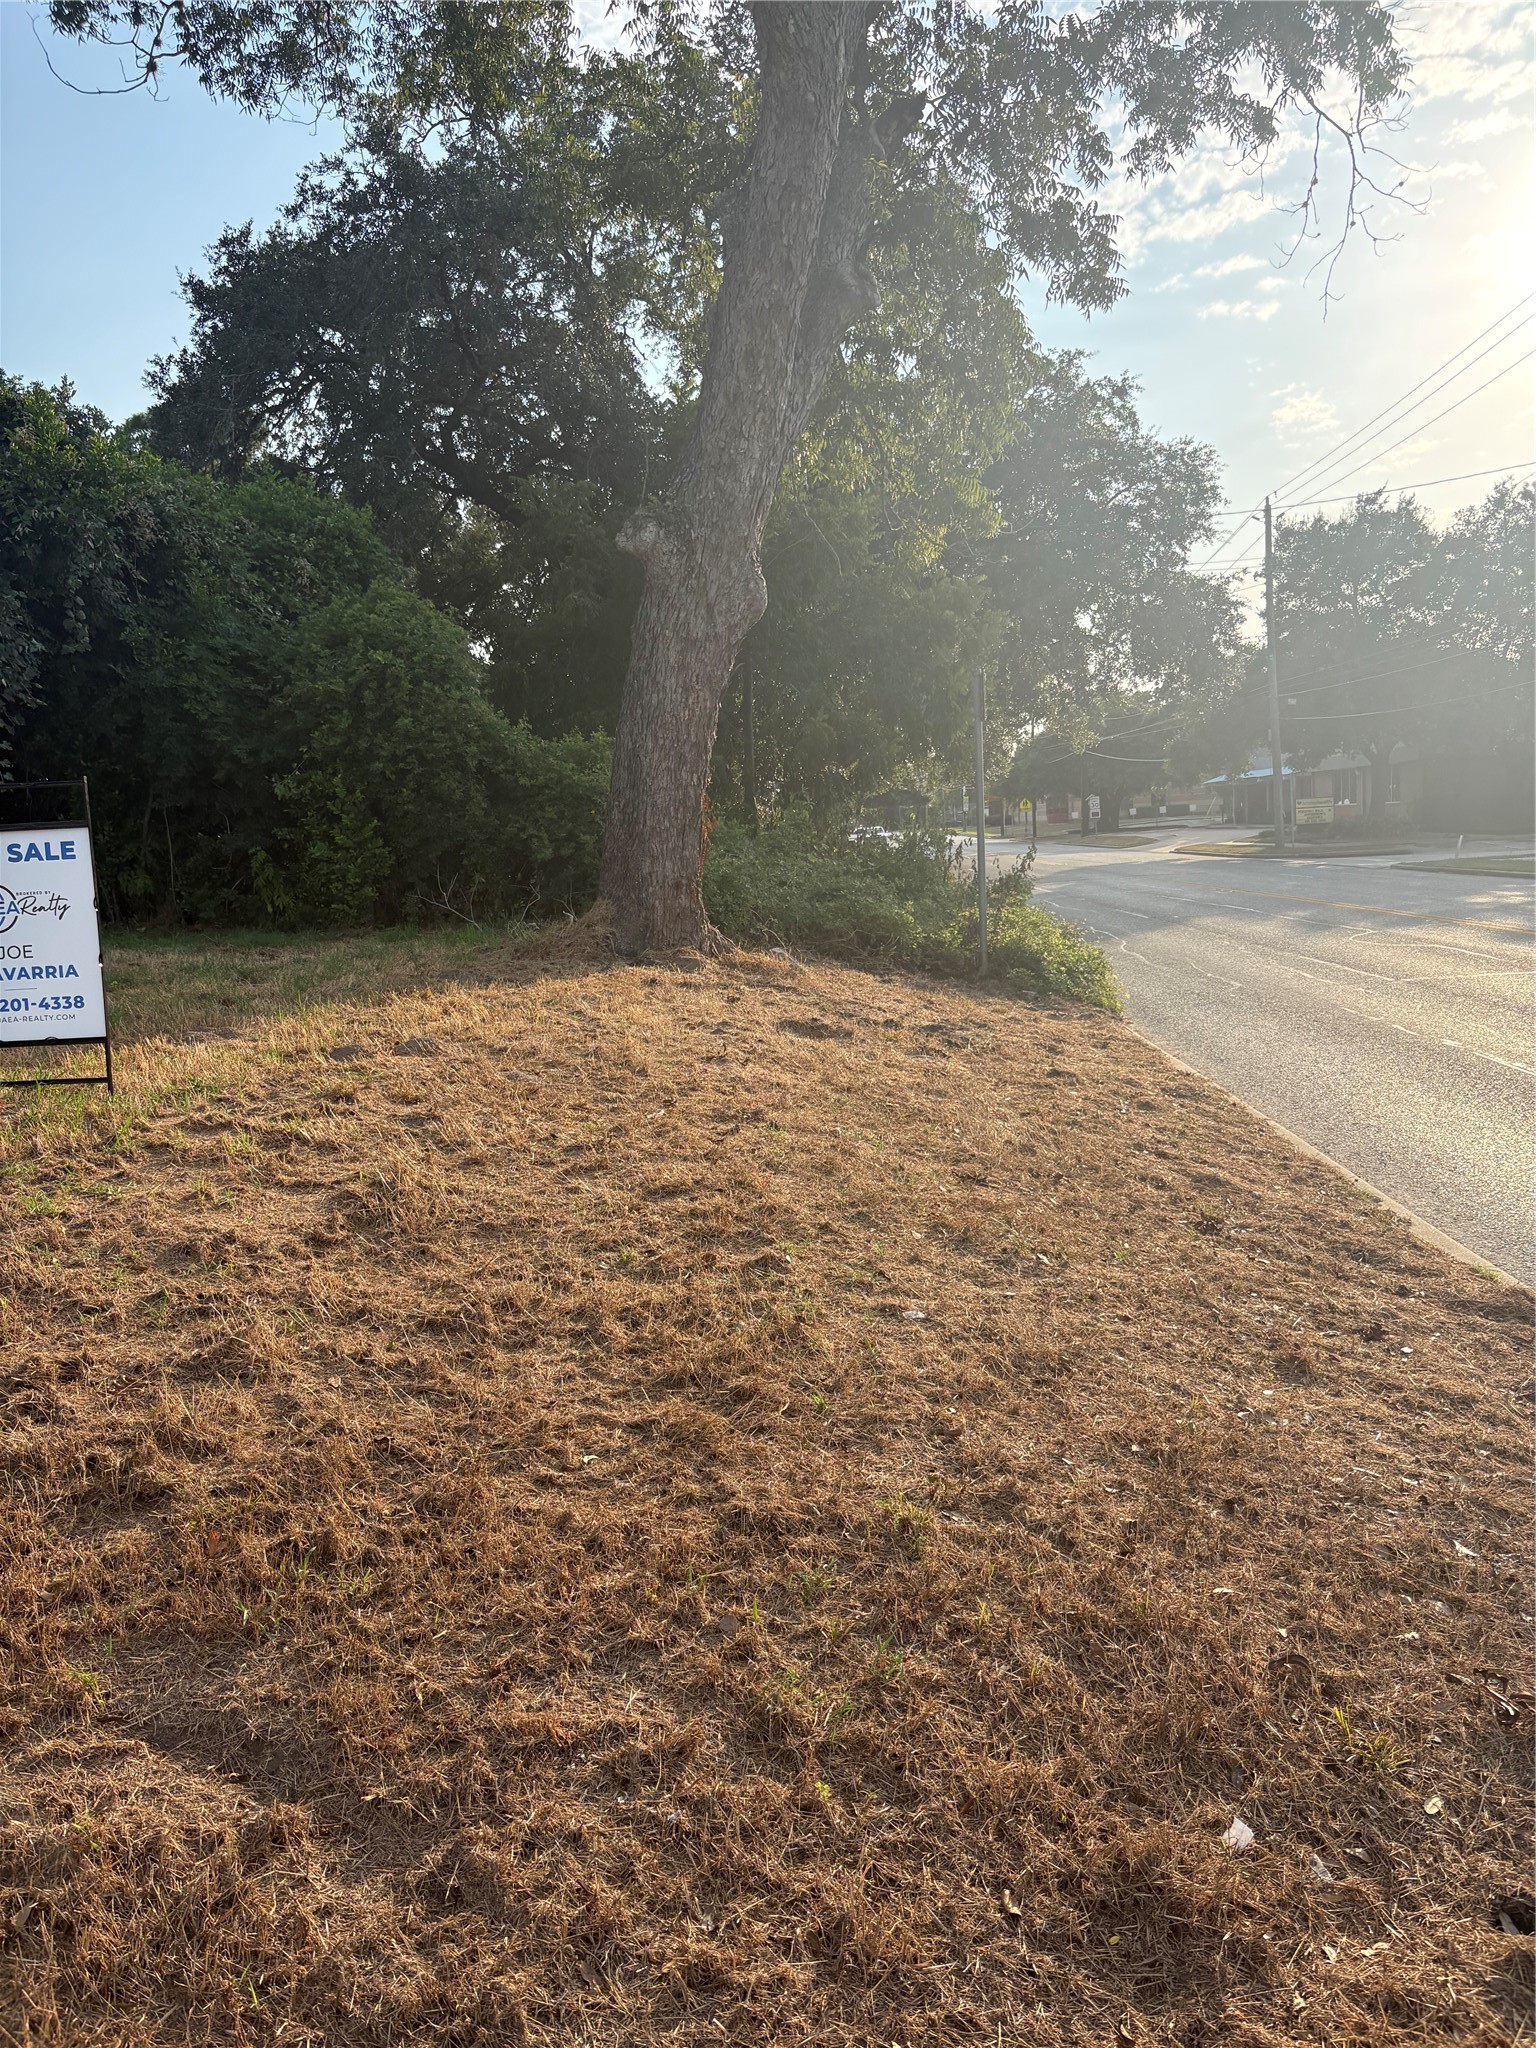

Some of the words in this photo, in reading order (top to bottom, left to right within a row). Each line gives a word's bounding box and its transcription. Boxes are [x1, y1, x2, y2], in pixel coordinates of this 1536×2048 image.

[7, 840, 77, 863] SALE
[17, 892, 71, 921] Realty
[0, 944, 34, 960] JOE
[0, 964, 80, 982] VARRIA
[0, 995, 85, 1012] 201-4338
[0, 1013, 76, 1024] AEA-REALTY.COM
